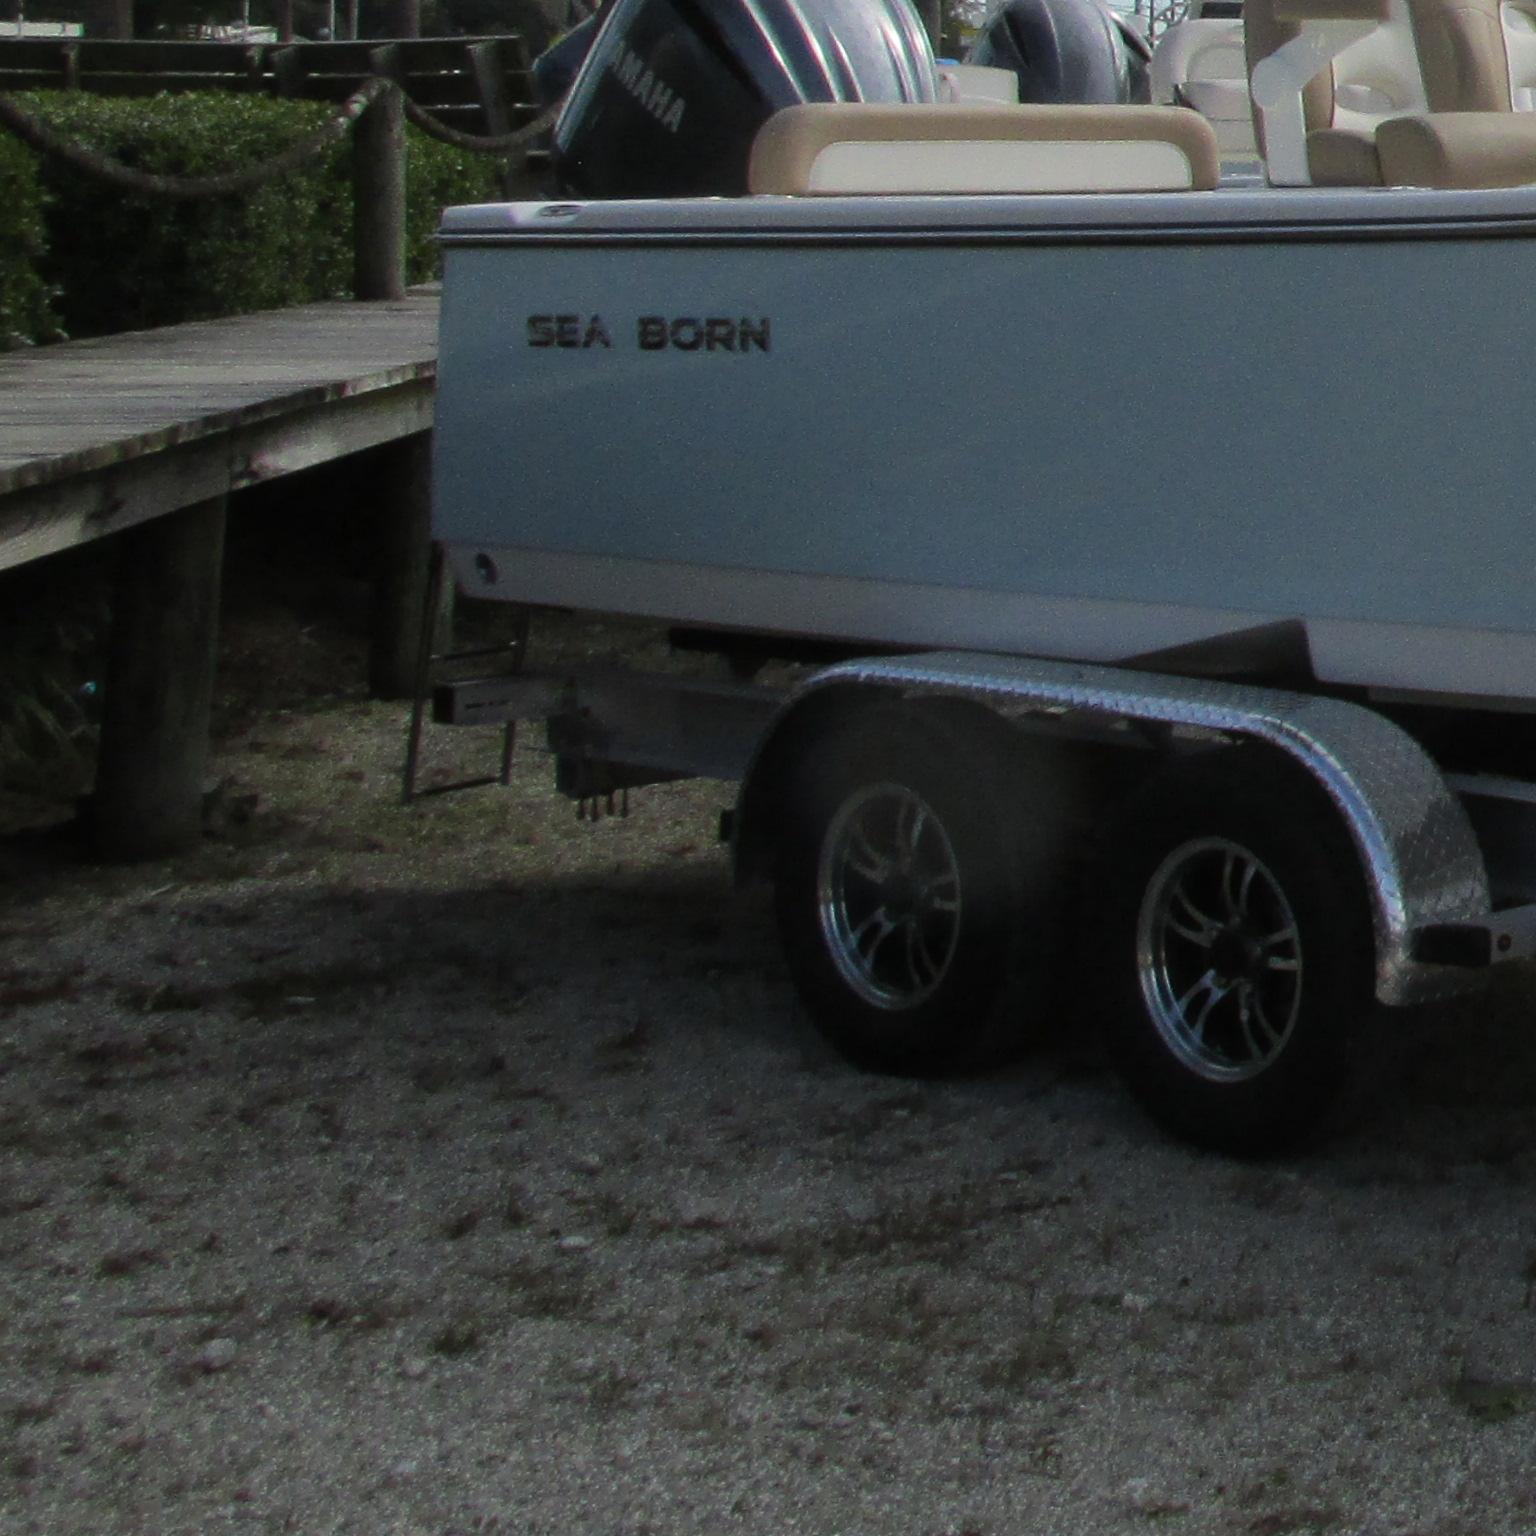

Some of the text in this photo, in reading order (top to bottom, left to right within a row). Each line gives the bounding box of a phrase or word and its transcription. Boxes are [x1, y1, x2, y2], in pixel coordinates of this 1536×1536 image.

[609, 40, 686, 133] AMAHA
[526, 314, 772, 353] SEA BORN
